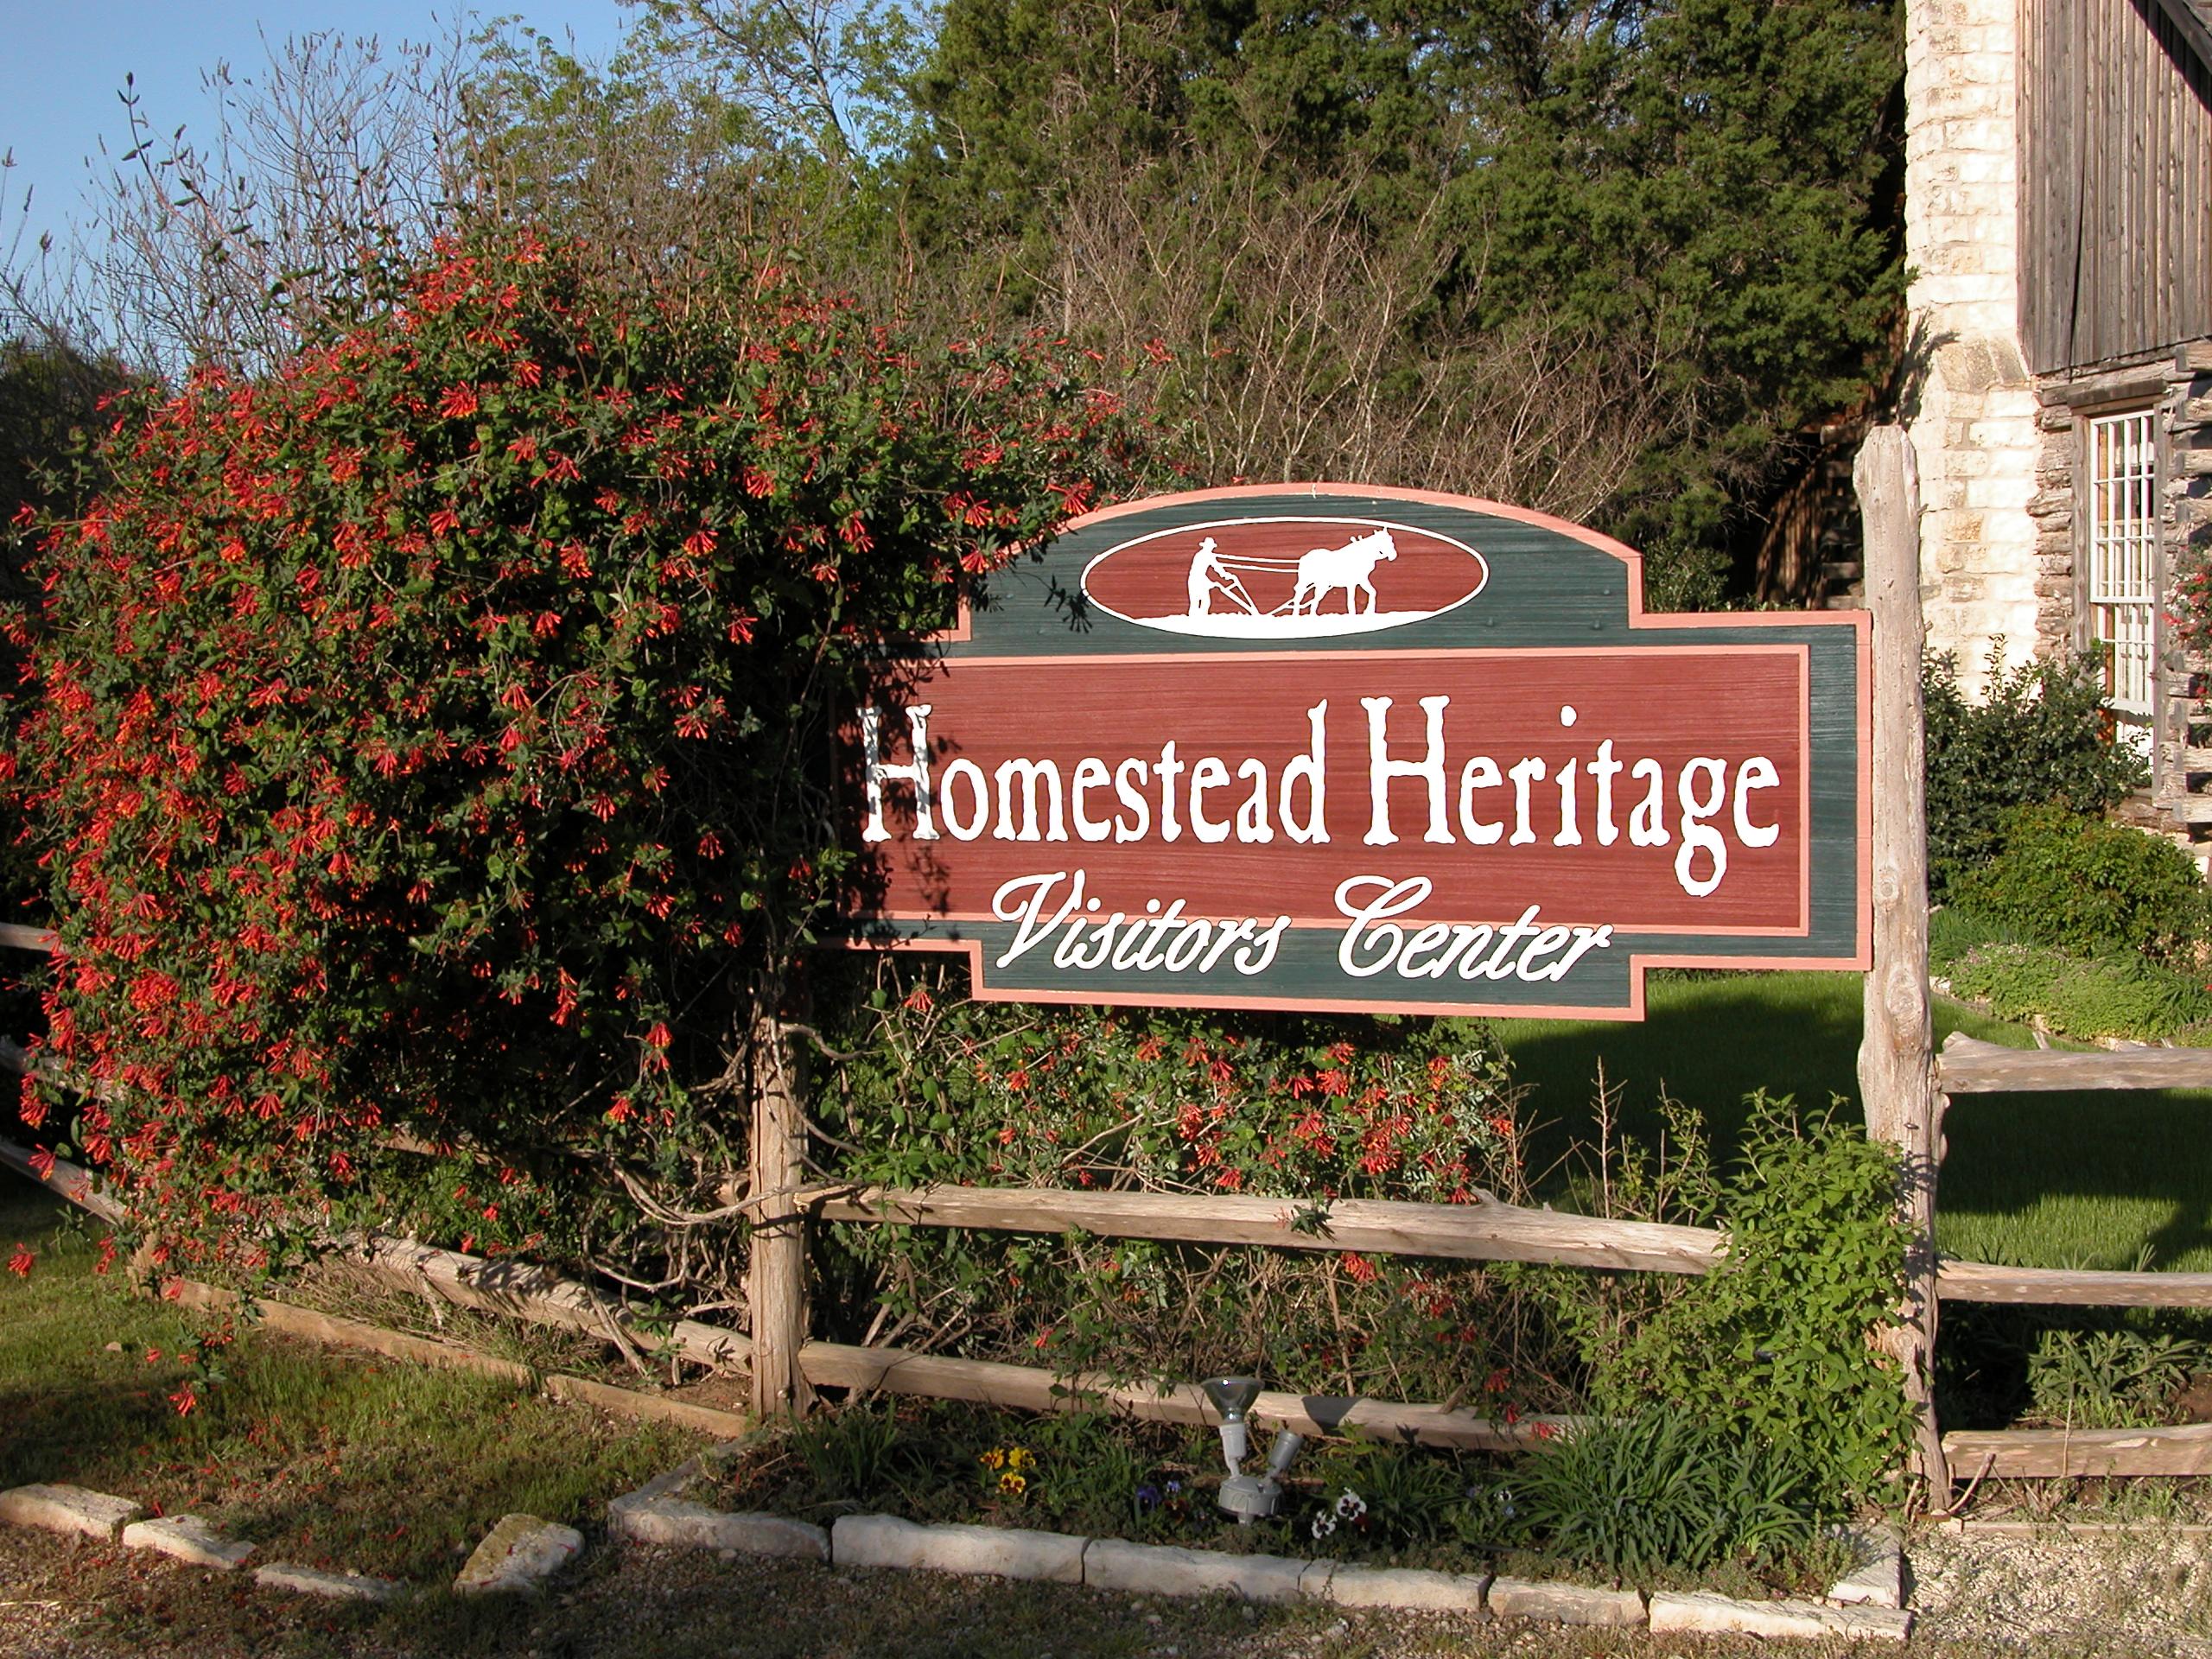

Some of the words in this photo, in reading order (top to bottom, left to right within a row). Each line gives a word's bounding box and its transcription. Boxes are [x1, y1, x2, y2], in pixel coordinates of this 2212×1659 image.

[857, 698, 1332, 844] Homestead
[1359, 695, 1781, 898] Heritage
[992, 868, 1292, 976] Visitors
[1333, 874, 1613, 982] Center
